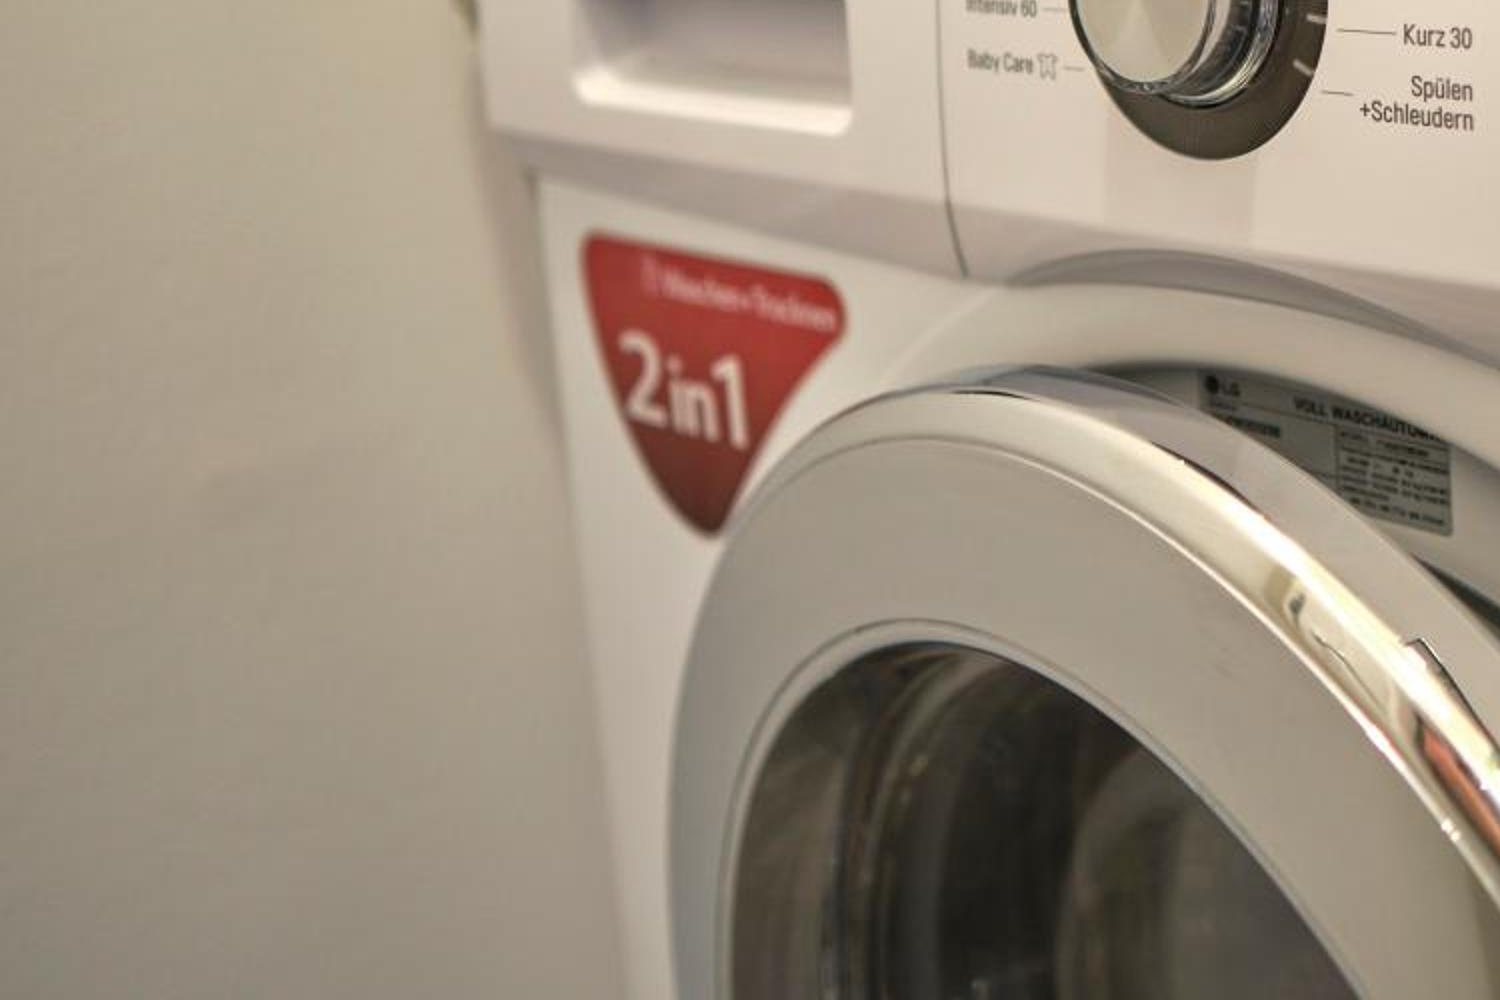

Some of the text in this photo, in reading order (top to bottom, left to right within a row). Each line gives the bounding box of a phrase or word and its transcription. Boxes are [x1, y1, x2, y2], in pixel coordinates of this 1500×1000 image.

[1403, 23, 1473, 50] Kurz 30
[966, 47, 1034, 75] Baby Care
[1410, 74, 1473, 102] Spülen
[1359, 99, 1475, 132] +Schleudern
[1294, 396, 1328, 417] VOLL
